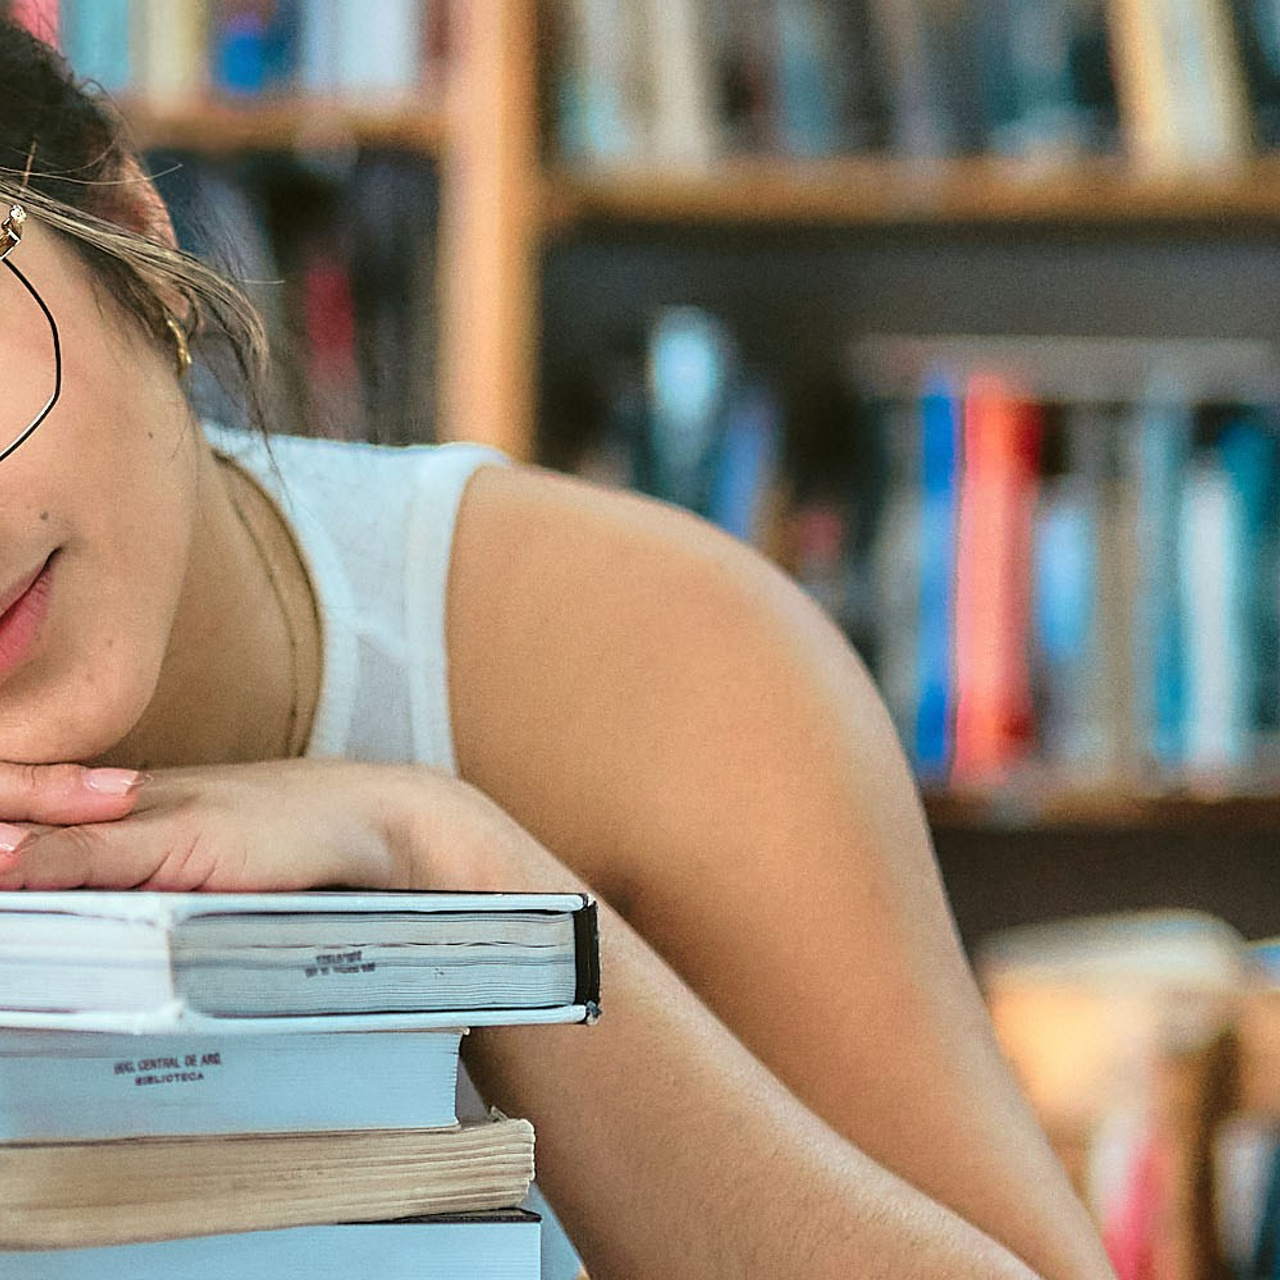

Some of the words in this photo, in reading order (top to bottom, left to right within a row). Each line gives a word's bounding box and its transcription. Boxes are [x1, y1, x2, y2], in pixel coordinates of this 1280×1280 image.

[138, 1056, 180, 1071] CENTRAL
[185, 1053, 197, 1066] DE
[135, 1072, 205, 1086] BIBLIOTECA
